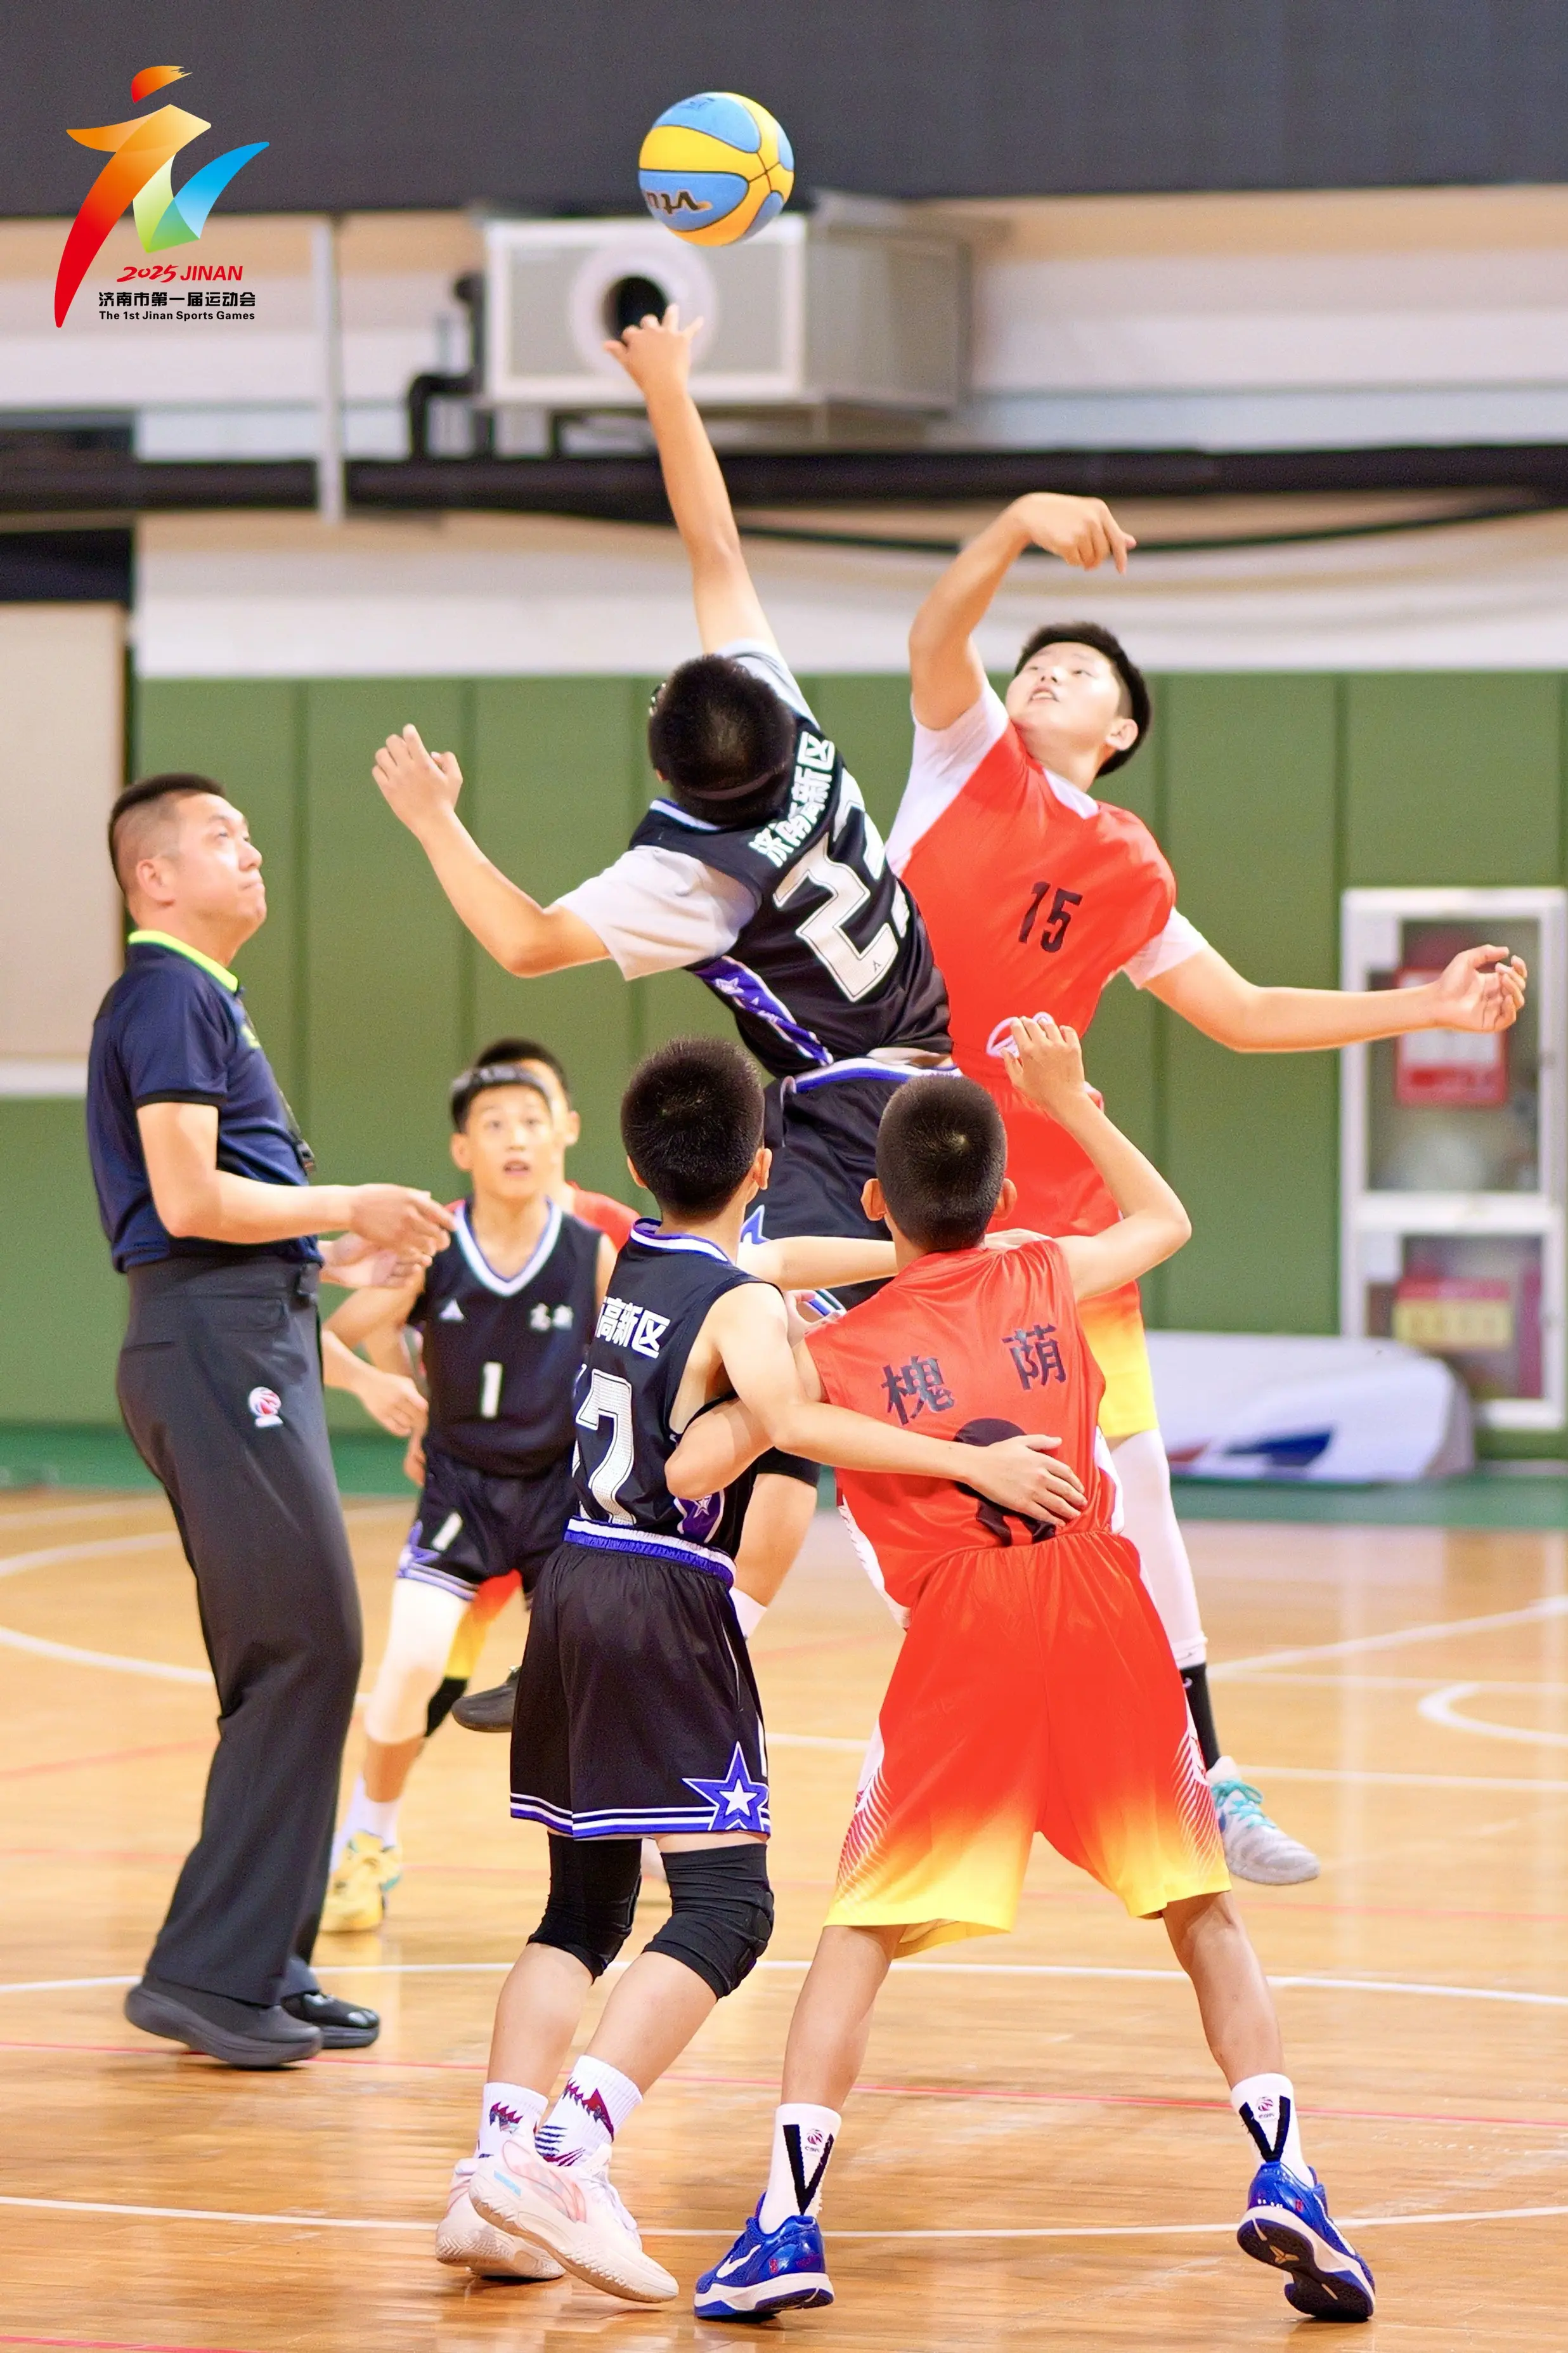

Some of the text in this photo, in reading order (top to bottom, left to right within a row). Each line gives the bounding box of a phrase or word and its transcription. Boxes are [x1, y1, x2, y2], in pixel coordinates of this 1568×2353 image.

[1018, 881, 1083, 953] 15
[595, 1296, 671, 1359] 高新区
[481, 1361, 502, 1419] 1
[571, 1364, 637, 1525] 7
